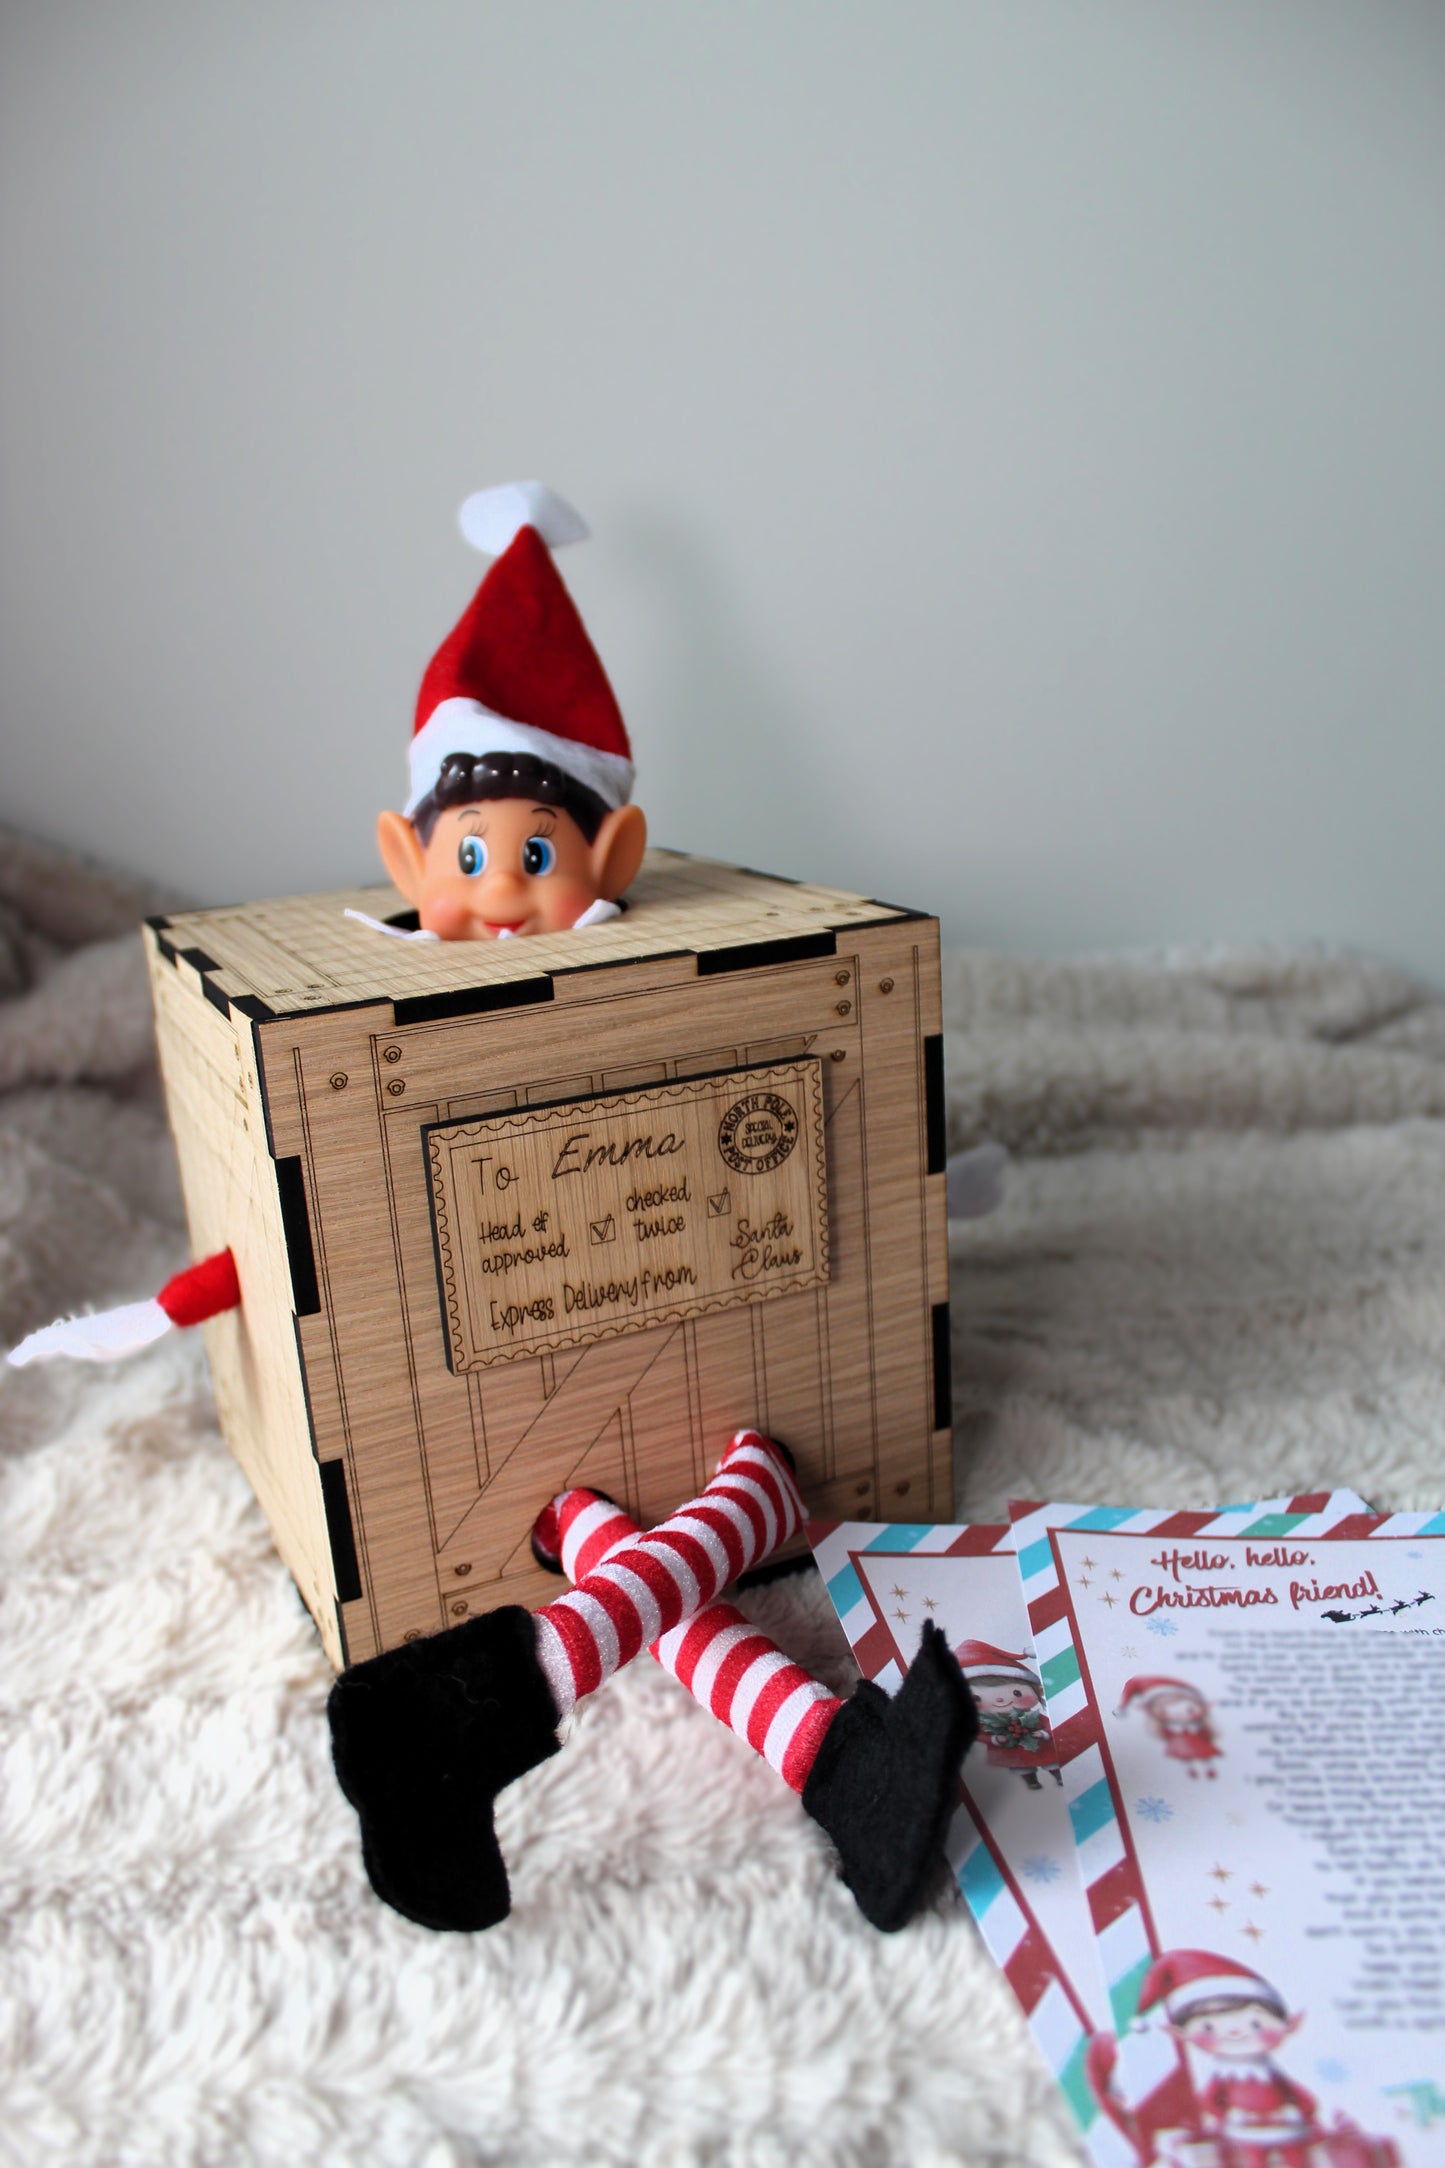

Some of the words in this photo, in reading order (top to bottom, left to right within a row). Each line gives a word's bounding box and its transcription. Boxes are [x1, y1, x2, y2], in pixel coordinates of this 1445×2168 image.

[723, 1096, 759, 1131] NORTH
[764, 1095, 792, 1119] POLE
[471, 1157, 519, 1195] To
[551, 1133, 686, 1180] Emma
[723, 1145, 752, 1172] POST
[756, 1135, 794, 1171] OFFICE
[626, 1176, 692, 1213] checked
[479, 1211, 526, 1244] Head
[532, 1210, 549, 1234] elf
[633, 1215, 686, 1241] twice
[730, 1211, 793, 1249] Santa
[482, 1233, 570, 1276] approved
[731, 1245, 803, 1281] Claus
[490, 1297, 556, 1335] Express
[563, 1280, 639, 1315] Delivery
[640, 1265, 698, 1300] from
[1129, 1584, 1279, 1616] Christmas
[1289, 1570, 1384, 1610] friend!
